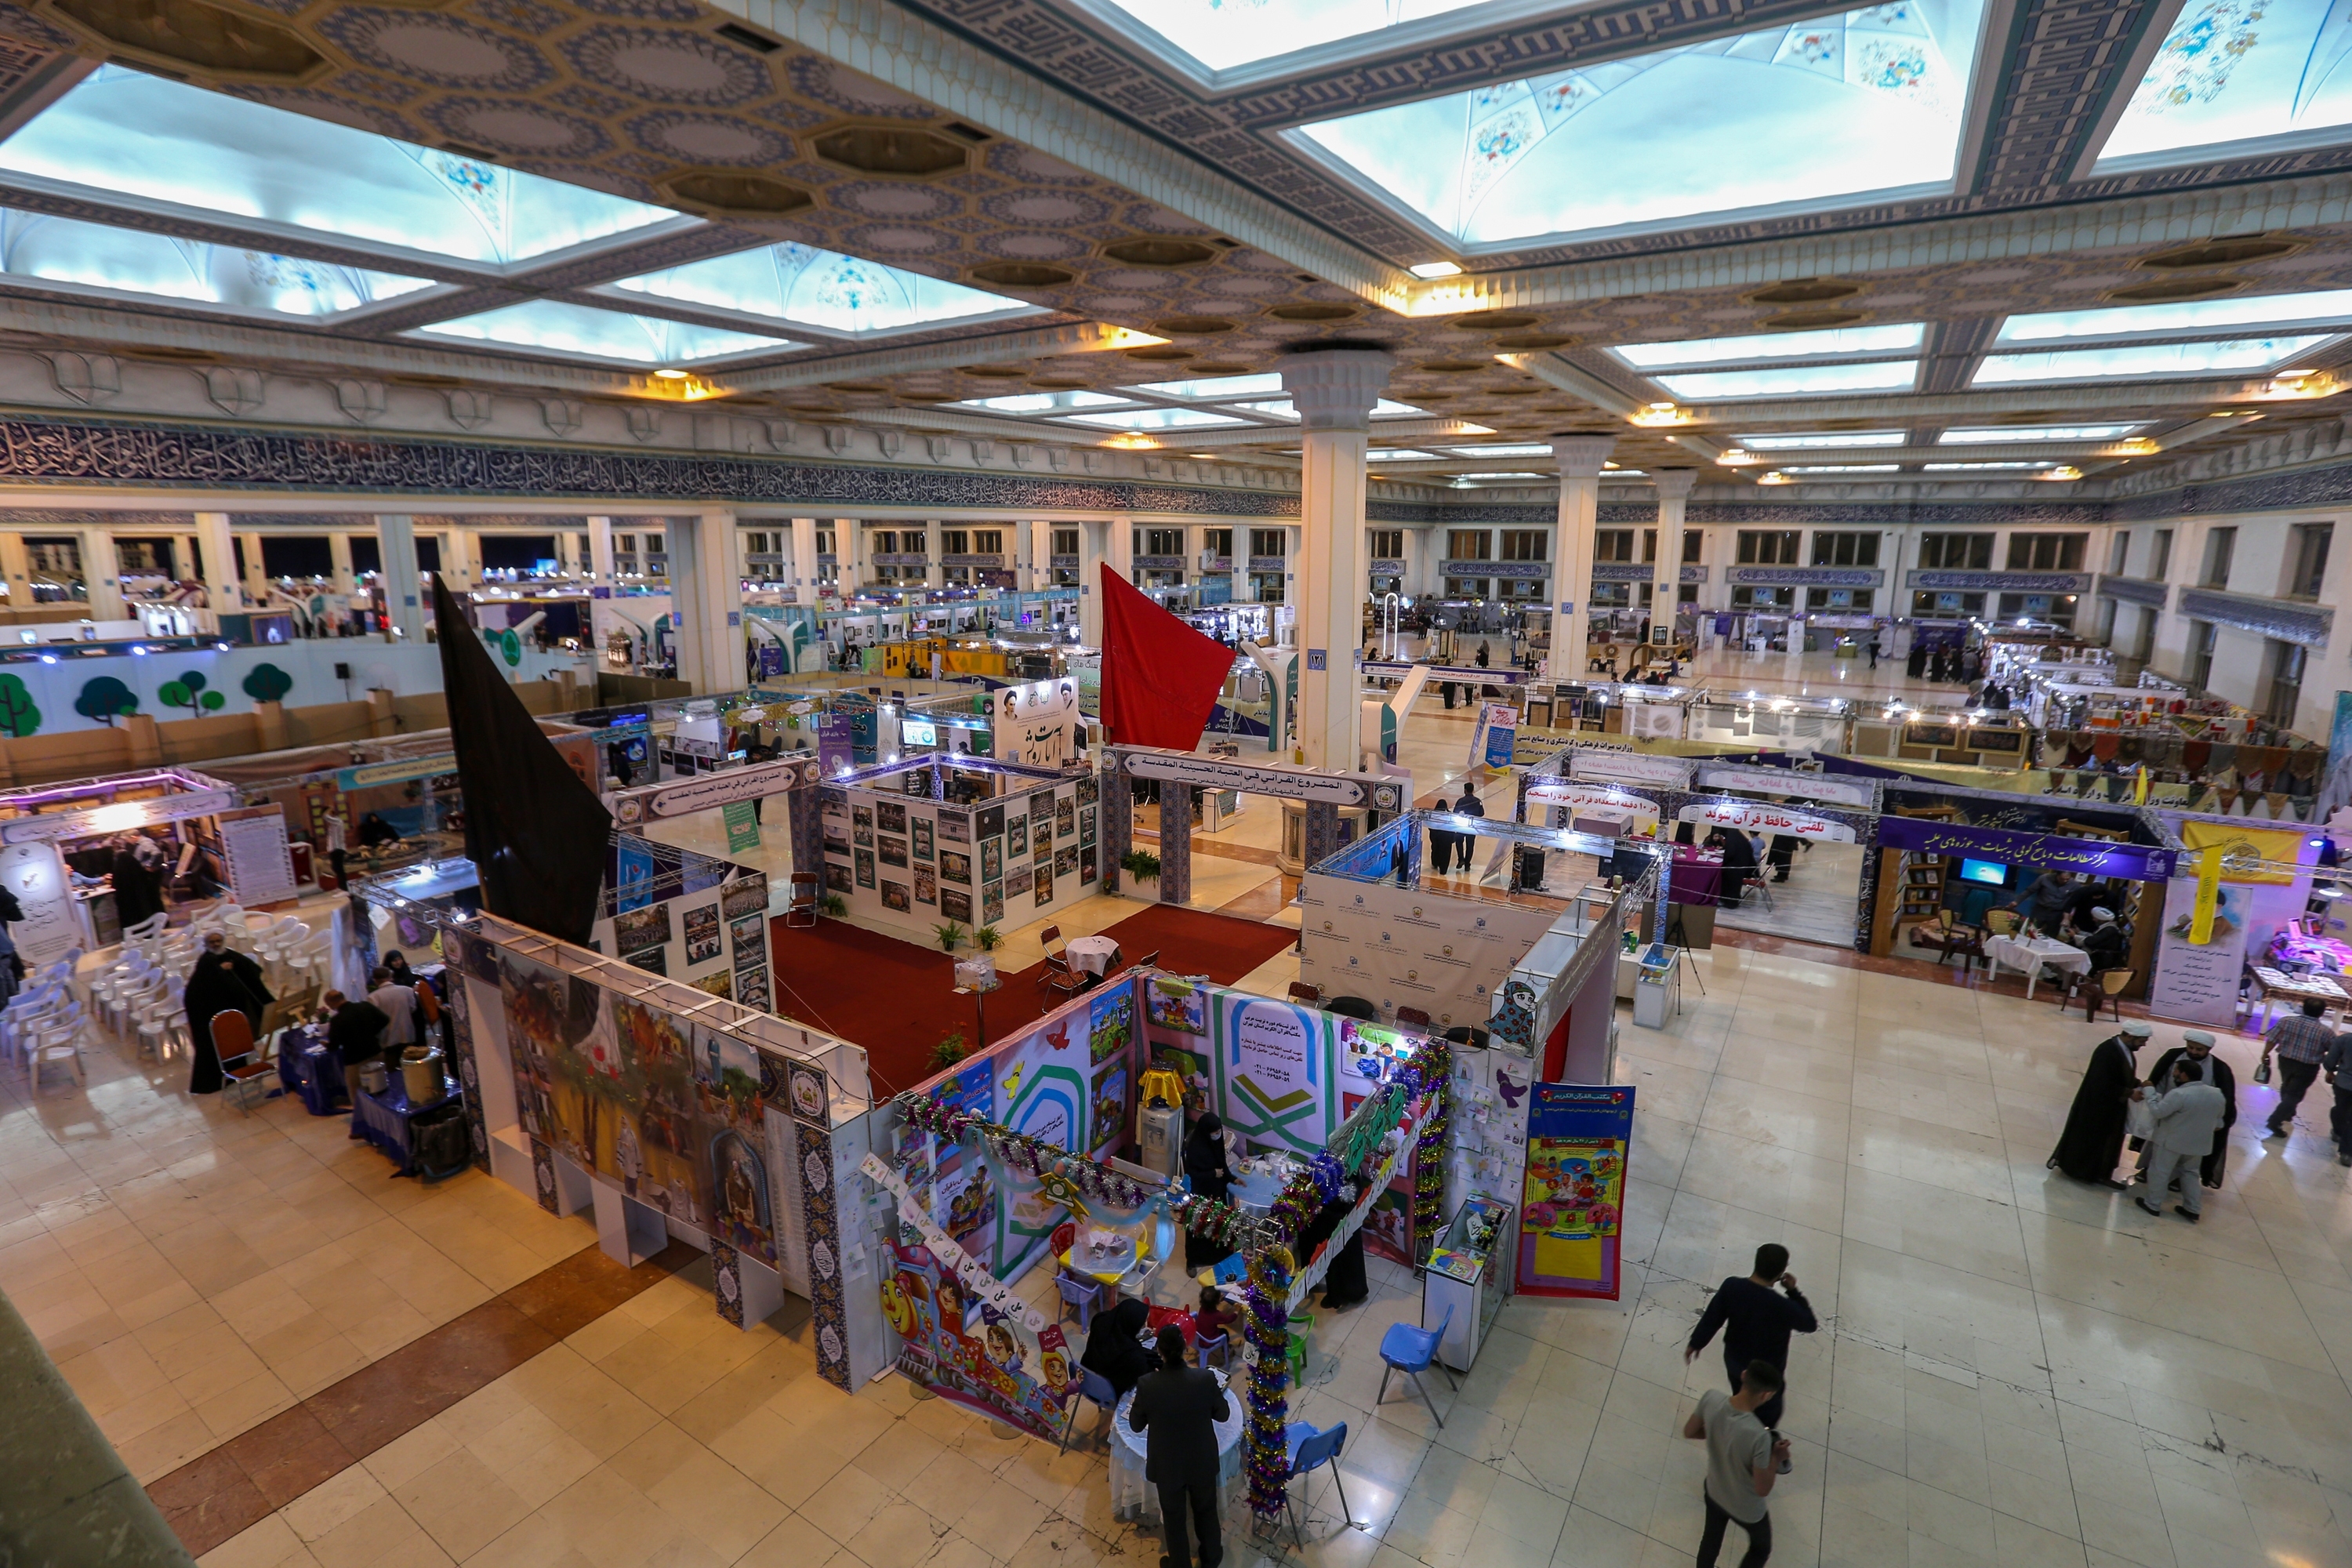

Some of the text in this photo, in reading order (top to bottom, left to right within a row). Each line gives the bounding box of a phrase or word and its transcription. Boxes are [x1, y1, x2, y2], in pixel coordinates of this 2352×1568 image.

[1084, 659, 1098, 669] سنگ
[1310, 654, 1323, 666] ۱۲۱
[1516, 734, 1530, 742] دستی
[1531, 735, 1545, 744] صنایع
[1550, 738, 1575, 746] گردشگری
[1579, 740, 1599, 750] فرهنگی
[1599, 742, 1615, 751] میراث
[1616, 743, 1633, 753] وزارت
[1142, 757, 1342, 789] المشروع القرآني في العتبة الحسينية المقدسة
[668, 772, 781, 800] المشروع القرآني في العتبة الحسينية المقدسة
[1527, 789, 1549, 799] بسنجید
[1550, 791, 1556, 801] را
[1558, 793, 1571, 802] خود
[1573, 795, 1592, 805] قرآنی
[1594, 797, 1619, 808] استعداد
[1621, 800, 1638, 809] دقیقه
[1639, 801, 1646, 810] ۱۰
[1705, 809, 1825, 833] تلفنی حافظ قرآن شوید
[2053, 851, 2093, 863] مطالعات
[2091, 846, 2116, 869] مرکز
[993, 1290, 1006, 1302] علی
